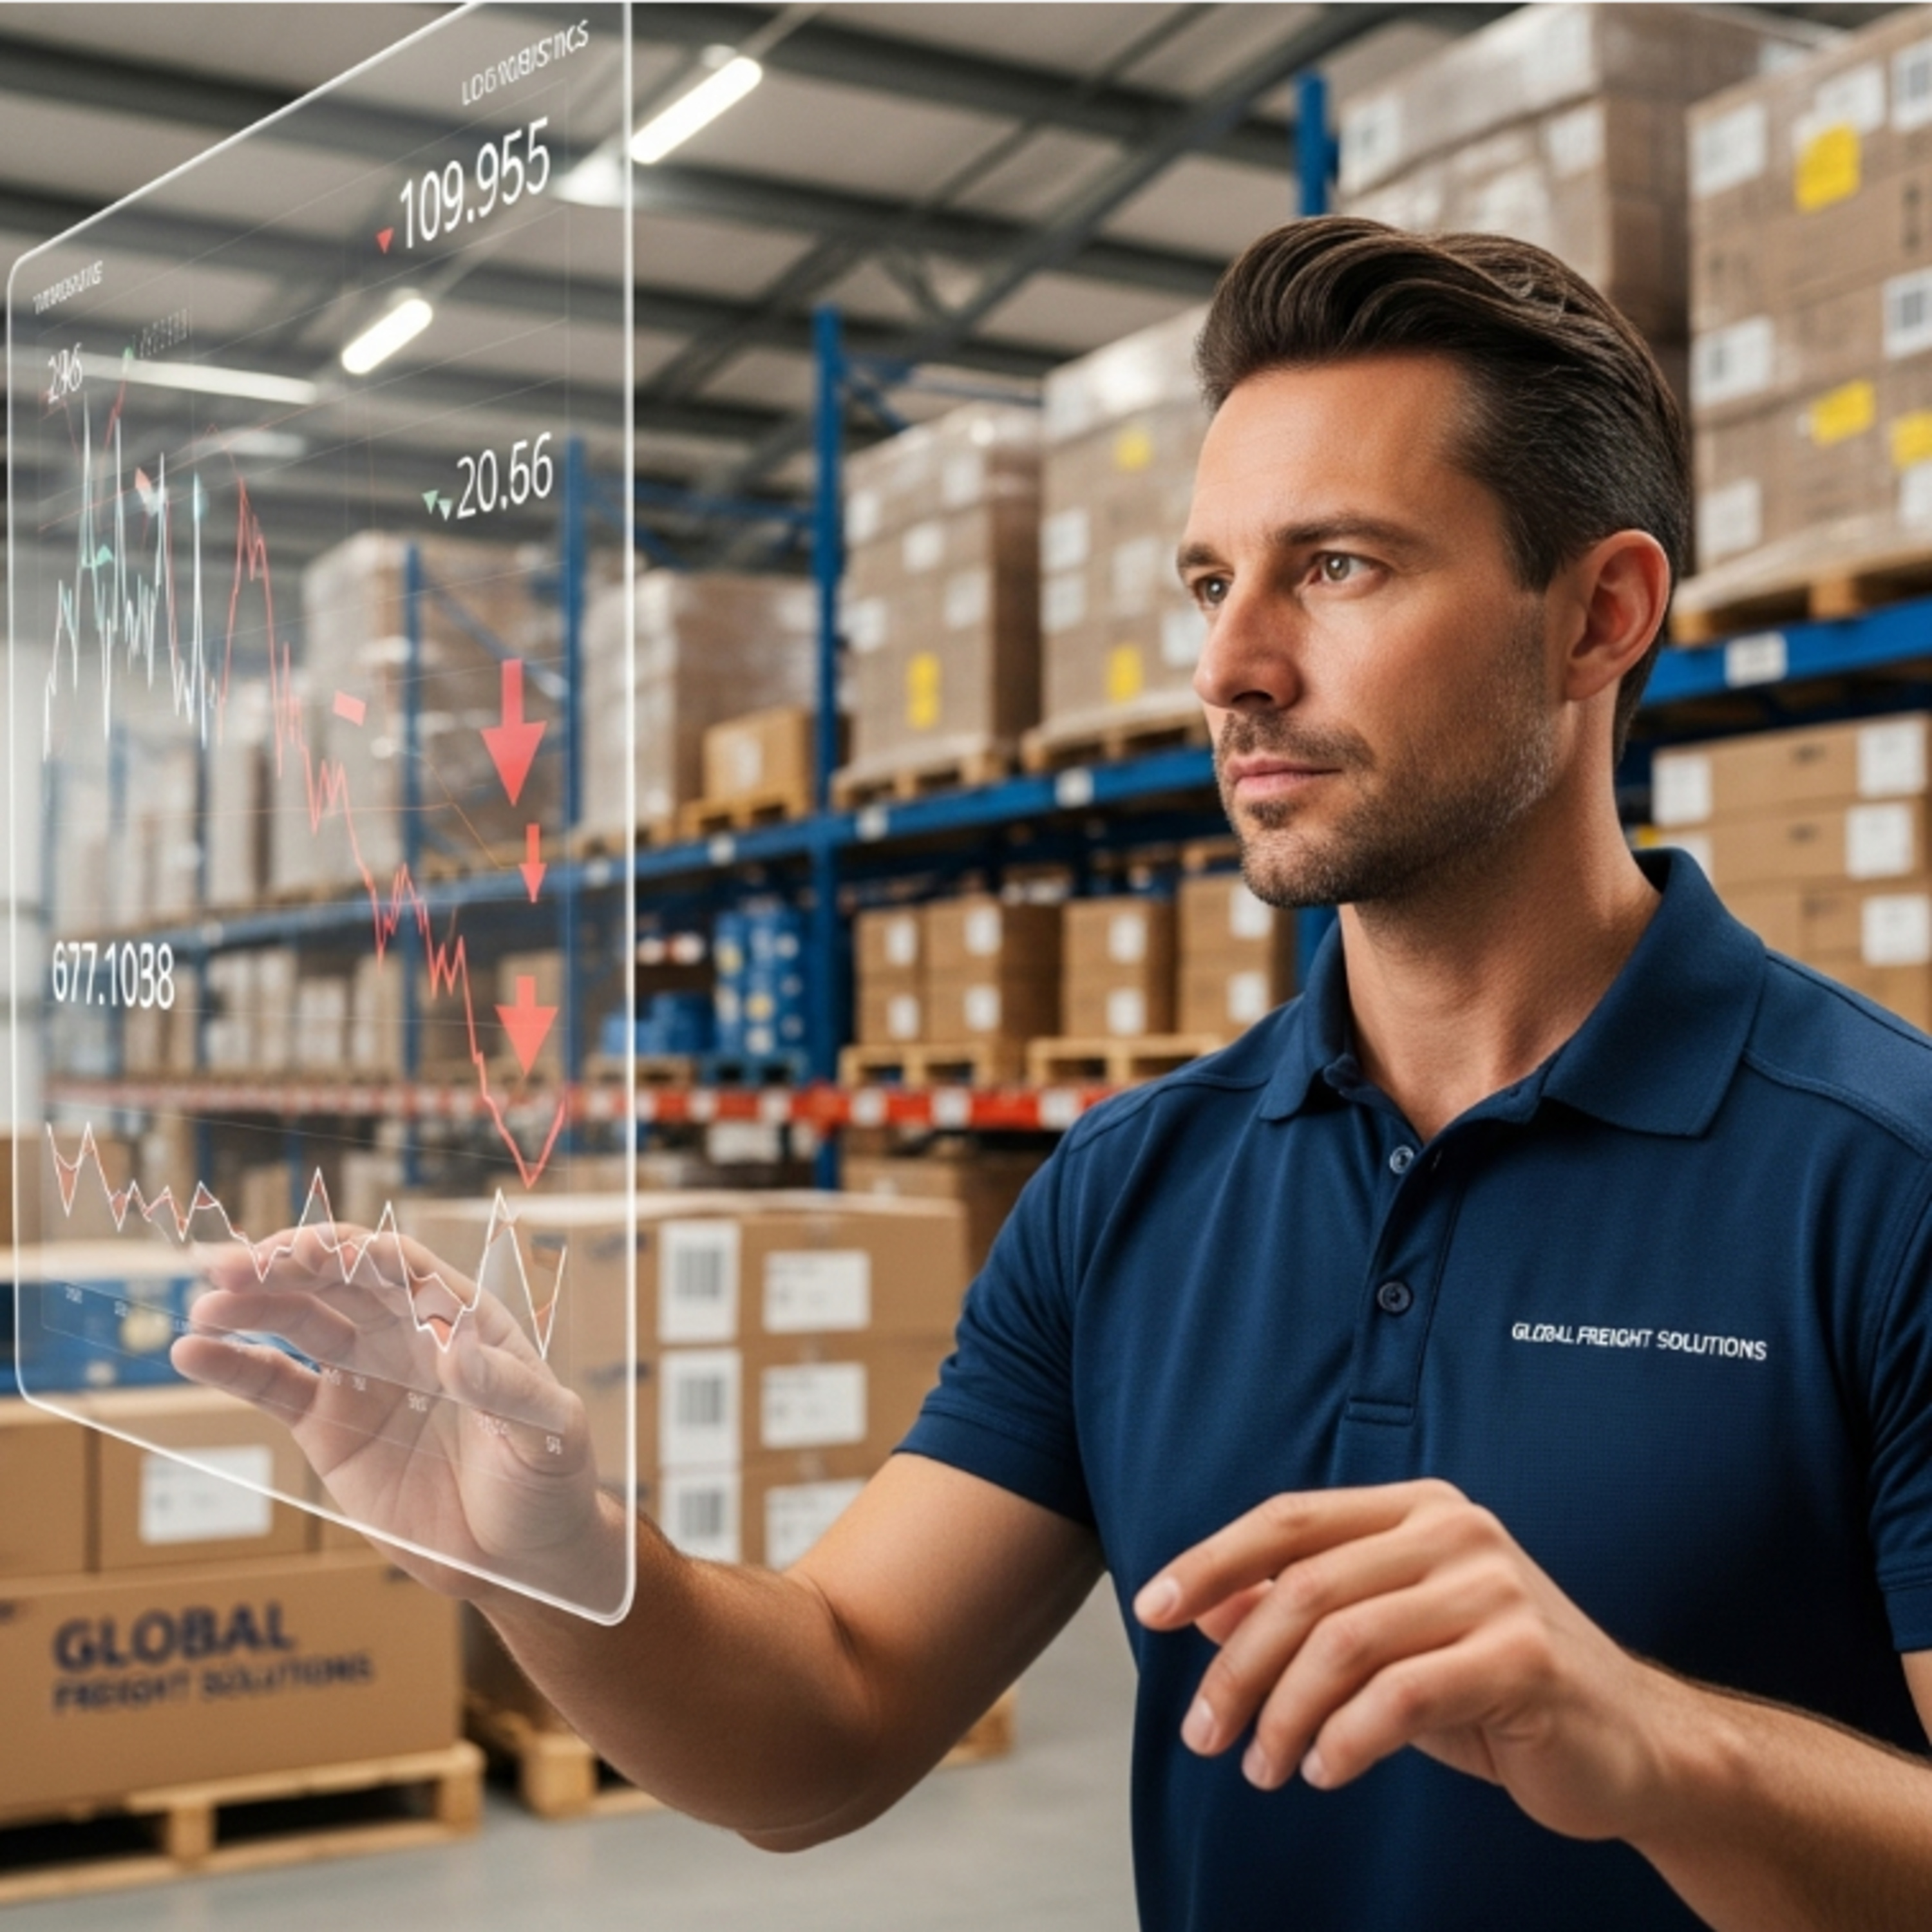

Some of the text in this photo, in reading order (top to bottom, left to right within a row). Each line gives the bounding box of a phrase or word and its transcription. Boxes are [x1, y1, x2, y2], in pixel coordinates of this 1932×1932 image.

[400, 115, 550, 249] 109.955
[1577, 1325, 1653, 1348] FREIGHT
[1656, 1330, 1768, 1361] SOLUTIONS
[53, 1600, 296, 1673] GLOBAL
